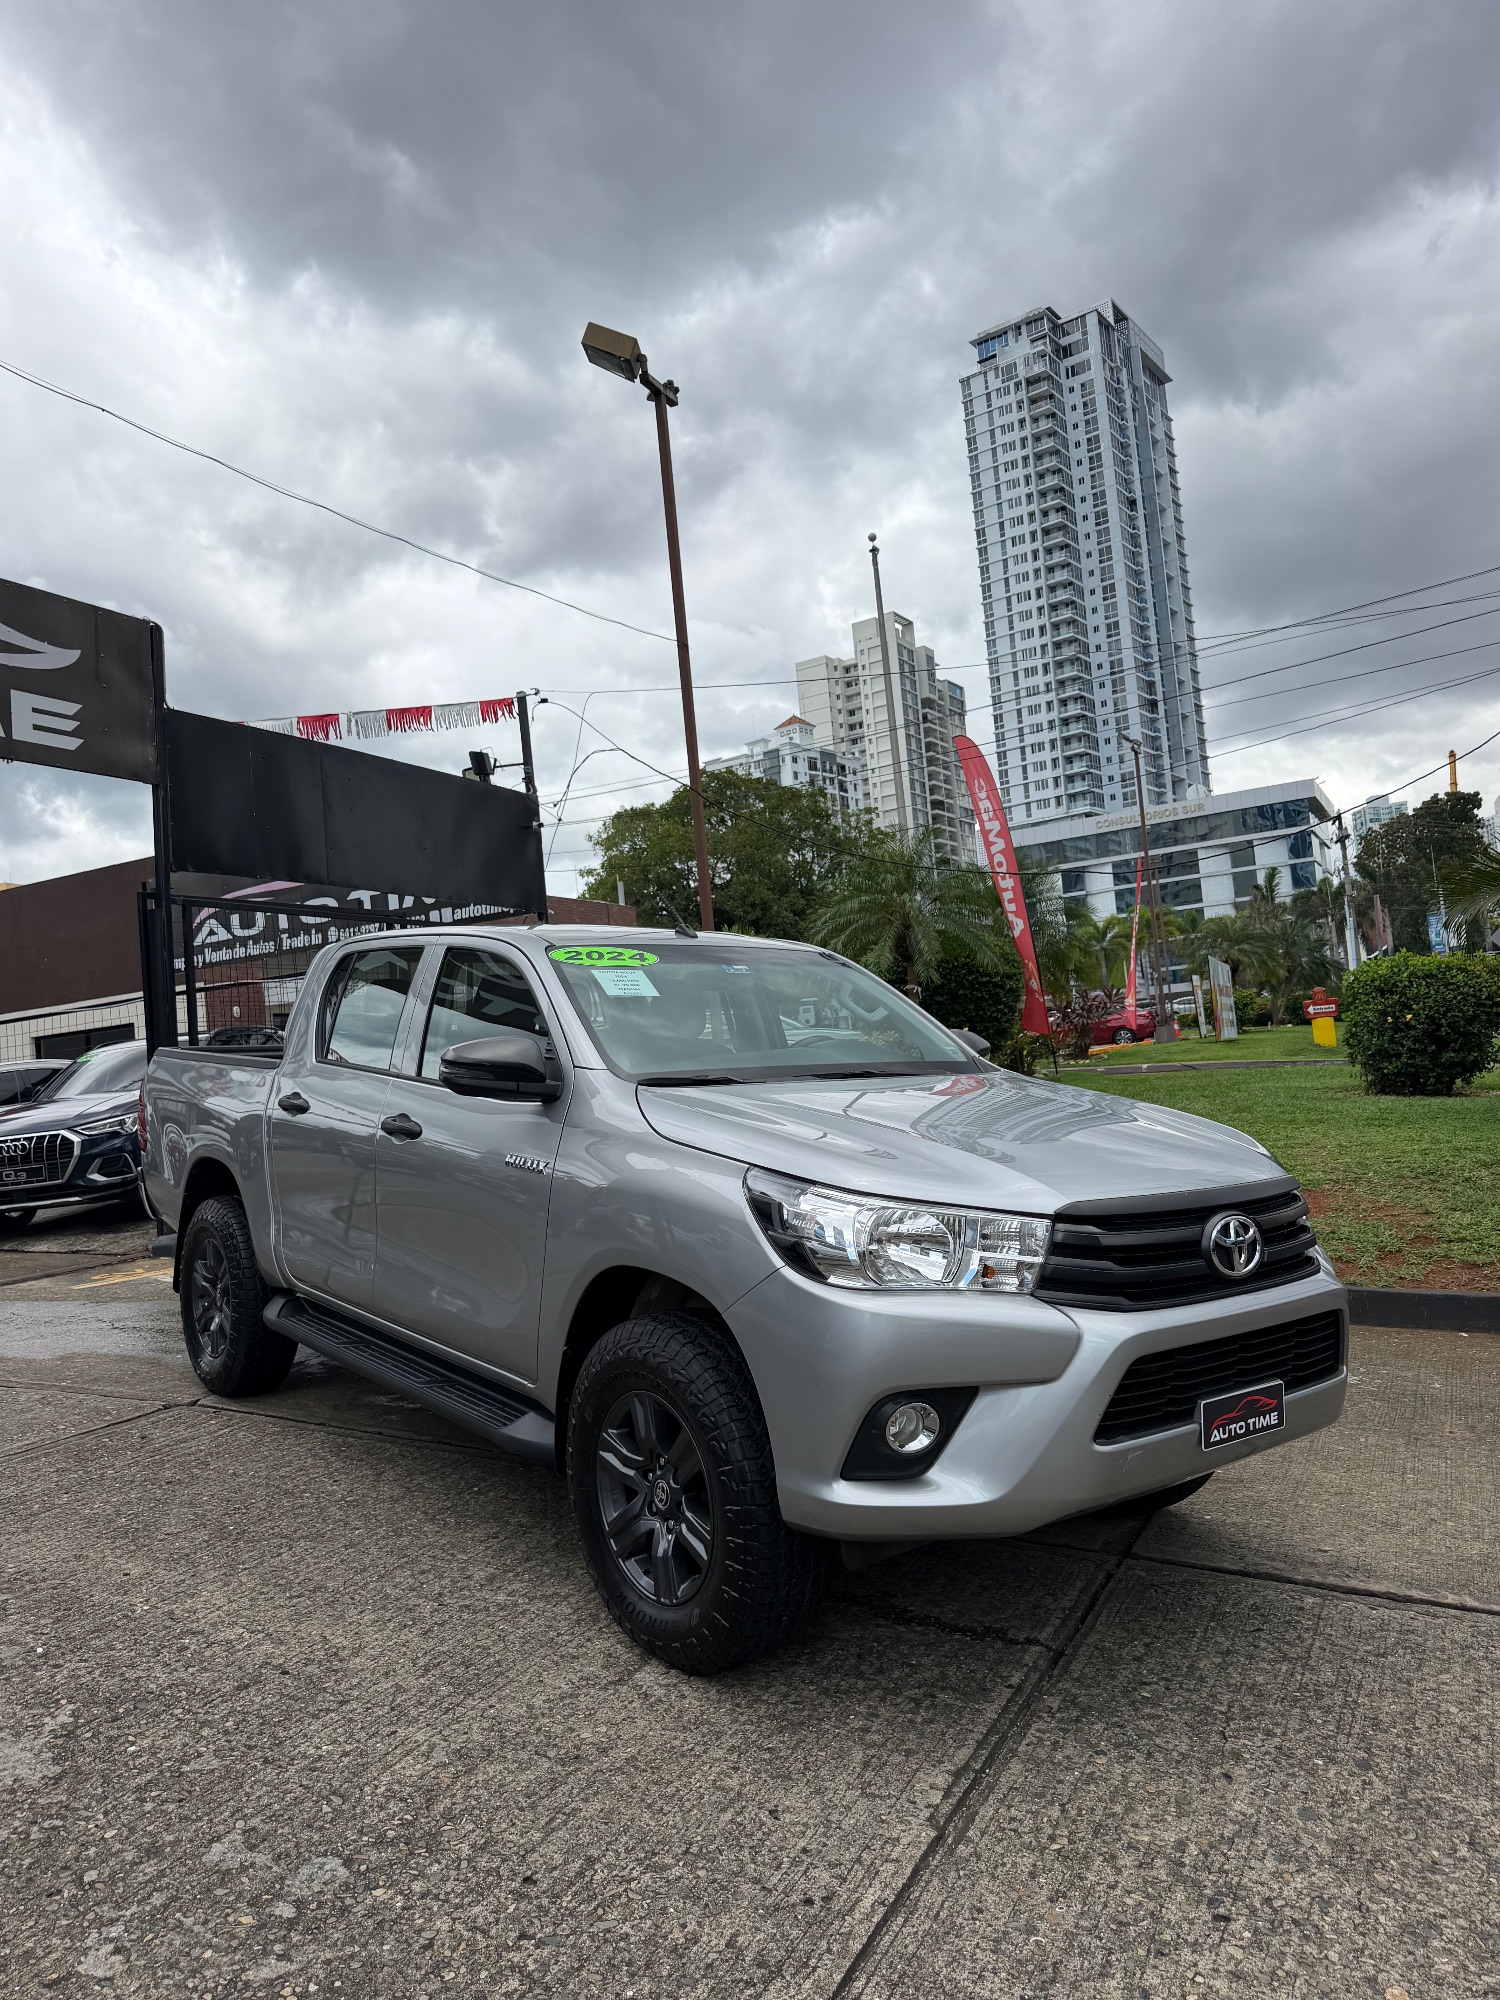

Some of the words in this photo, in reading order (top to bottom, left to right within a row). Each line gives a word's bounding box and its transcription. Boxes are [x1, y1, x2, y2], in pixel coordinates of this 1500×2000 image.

[1095, 807, 1179, 829] CONSULORIOS
[1181, 802, 1206, 815] SUR
[205, 947, 232, 964] Venta
[233, 942, 246, 958] de
[246, 939, 275, 956] Autos
[281, 931, 311, 950] Trade
[563, 950, 649, 962] 2024
[2, 1170, 27, 1181] Q3
[505, 1152, 550, 1176] HILUX
[792, 1218, 821, 1231] HILUX
[1210, 1421, 1245, 1442] AUTO
[1247, 1411, 1279, 1431] TIME
